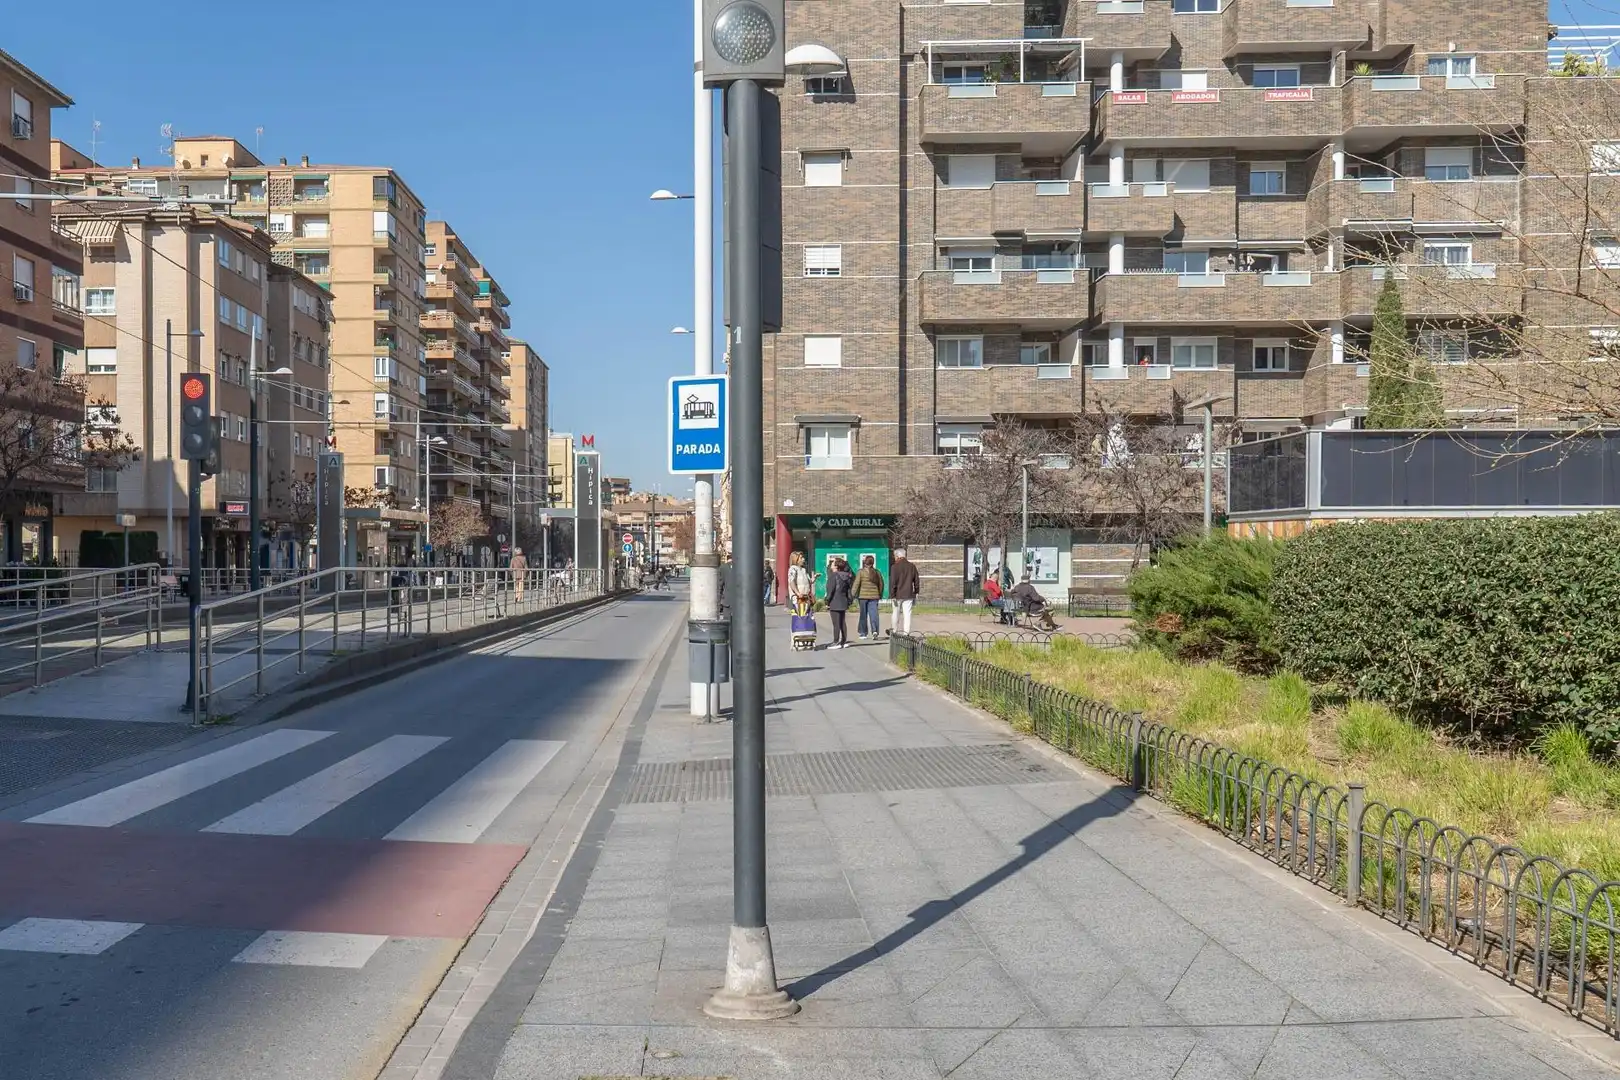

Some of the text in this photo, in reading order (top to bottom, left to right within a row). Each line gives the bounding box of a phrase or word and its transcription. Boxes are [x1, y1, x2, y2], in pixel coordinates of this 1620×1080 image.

[733, 326, 742, 344] 1
[324, 435, 337, 448] M
[582, 434, 595, 448] M
[676, 443, 721, 455] PARADA
[828, 518, 884, 527] CAJA RURAL
